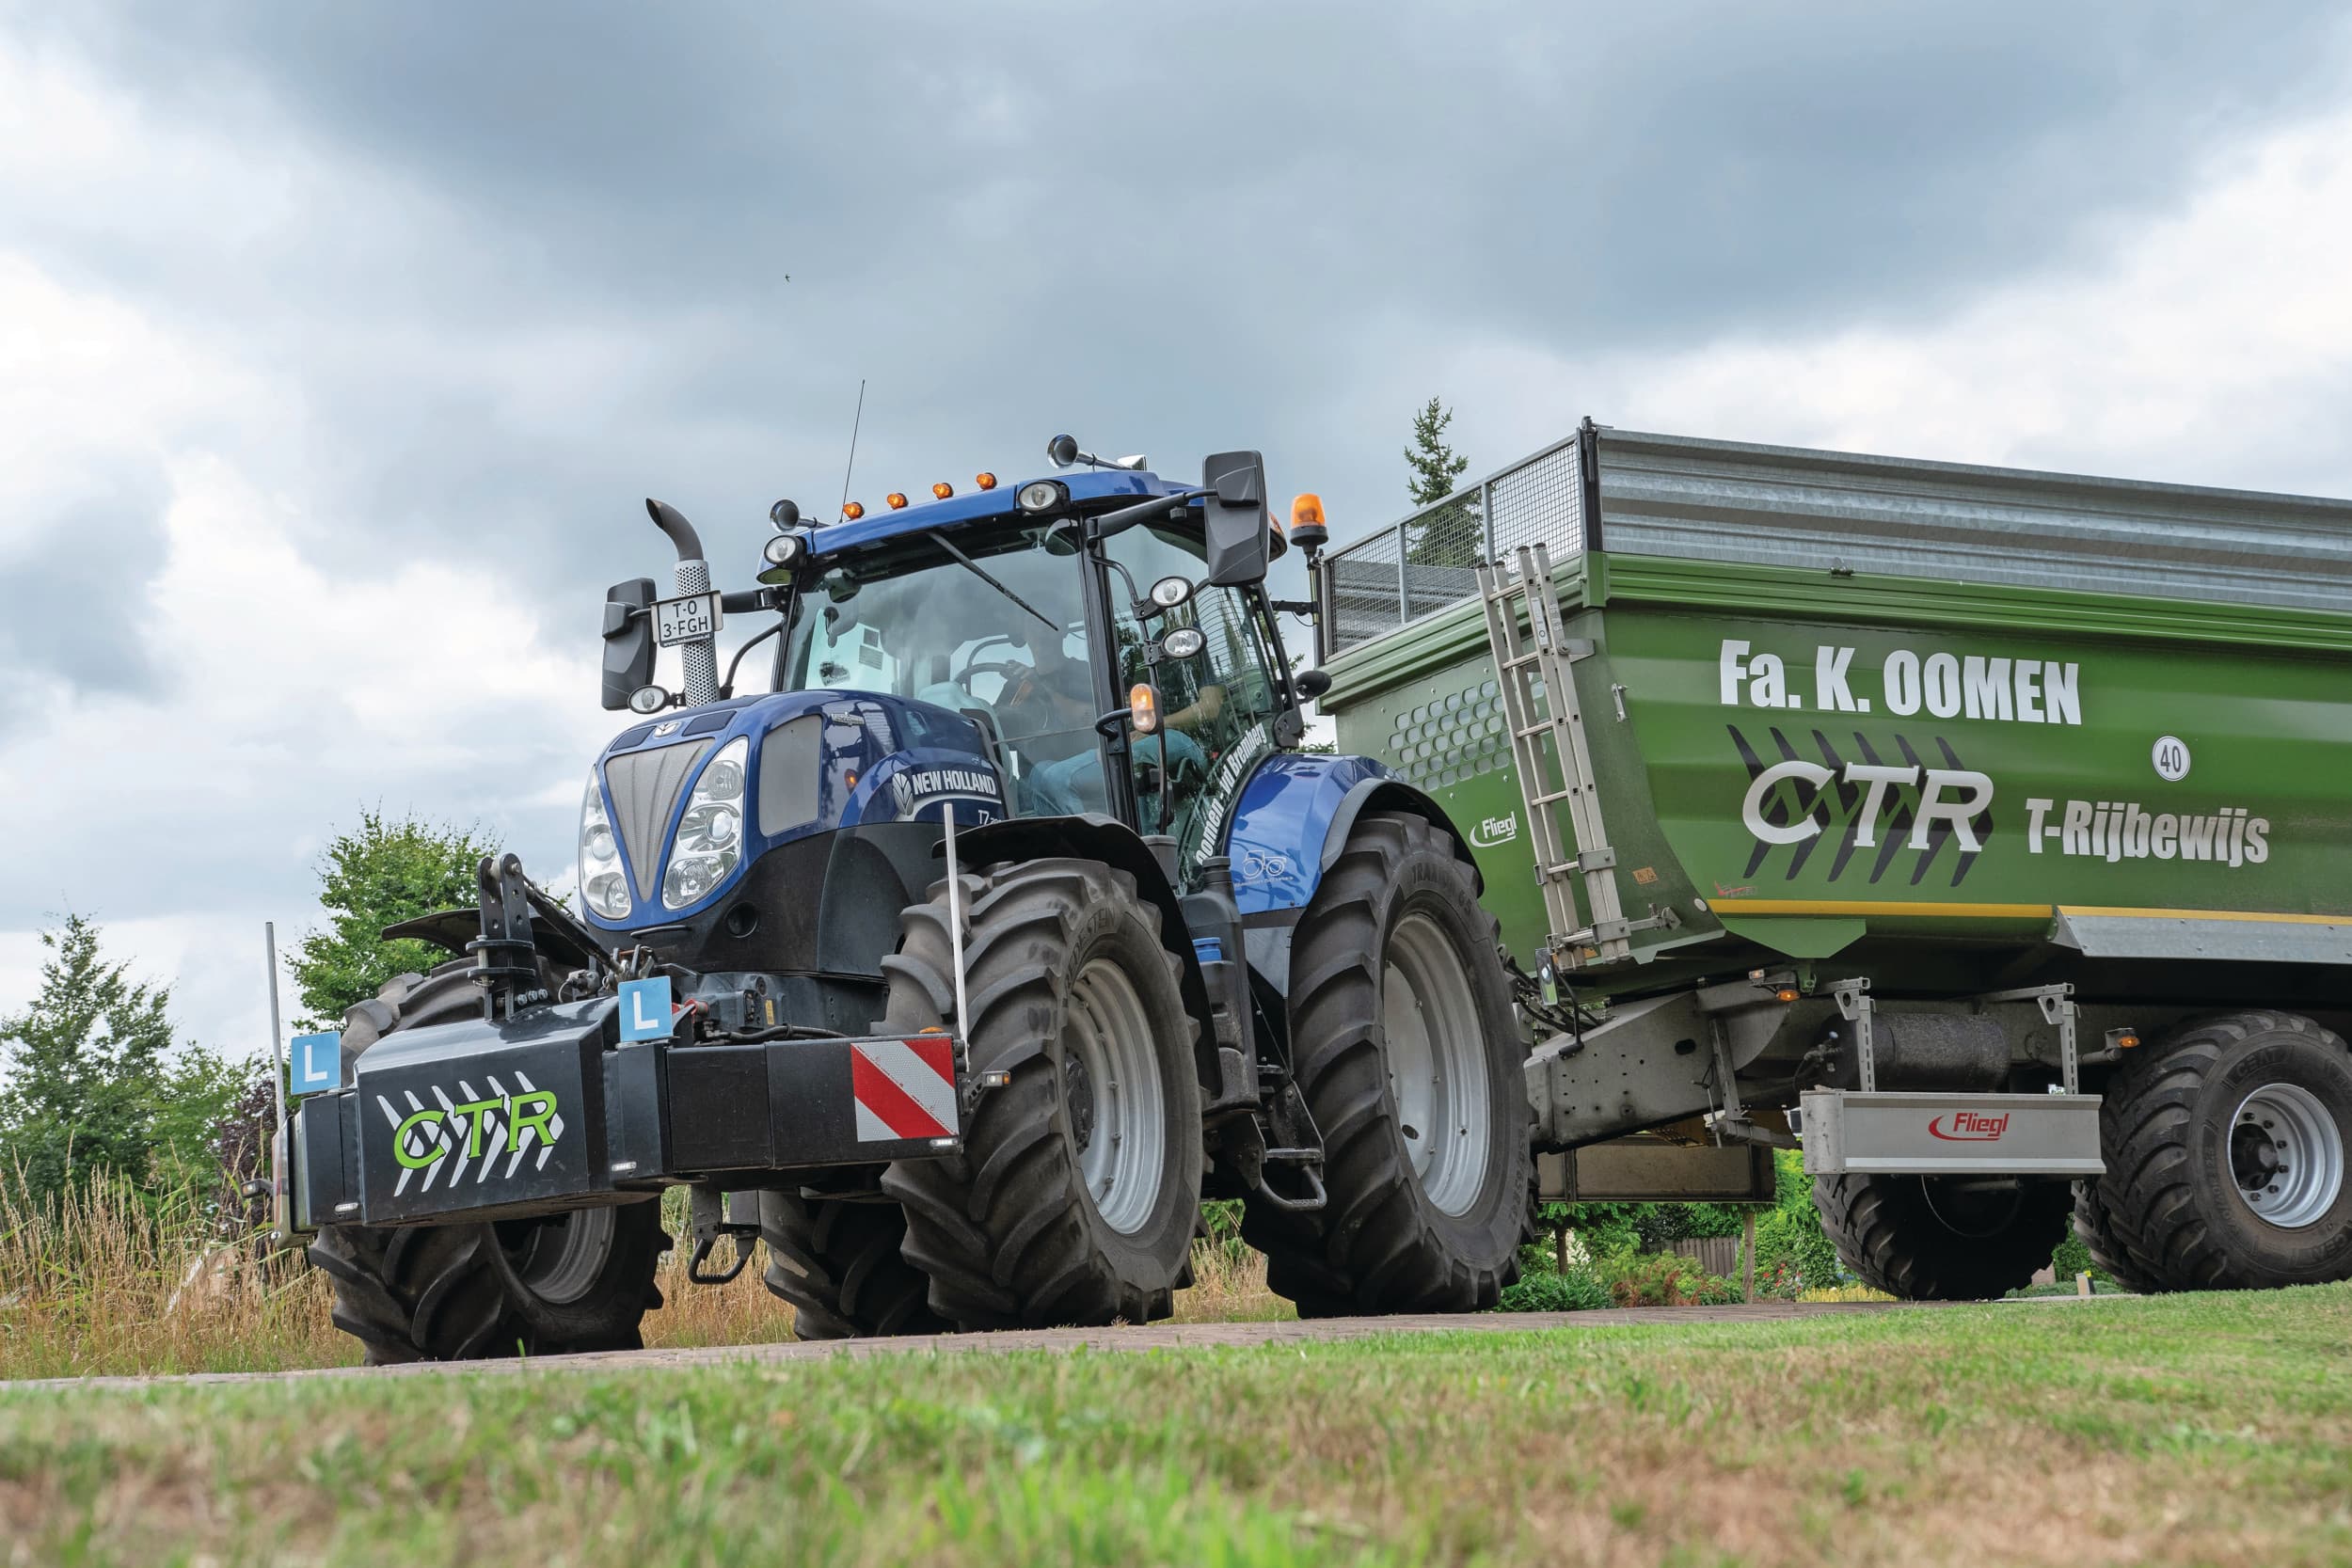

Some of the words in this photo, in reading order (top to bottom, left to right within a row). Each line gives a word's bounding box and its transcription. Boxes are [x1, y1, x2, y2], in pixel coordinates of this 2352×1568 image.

[663, 616, 708, 638] 3-FGH
[1720, 639, 1802, 708] Fa.
[1816, 645, 1870, 712] K.
[1883, 649, 2082, 725] OOMEN
[1226, 721, 1267, 777] Bremberg
[2160, 745, 2182, 772] 40
[912, 770, 942, 795] NEW
[943, 769, 996, 796] HOLLAND
[1482, 811, 1518, 839] Fliegl
[1742, 760, 1994, 852] CTR
[2026, 798, 2270, 867] T-Rijbewijs
[633, 990, 659, 1031] L
[304, 1044, 328, 1083] L
[394, 1090, 558, 1169] CTR
[1953, 1113, 2010, 1136] Fliegl
